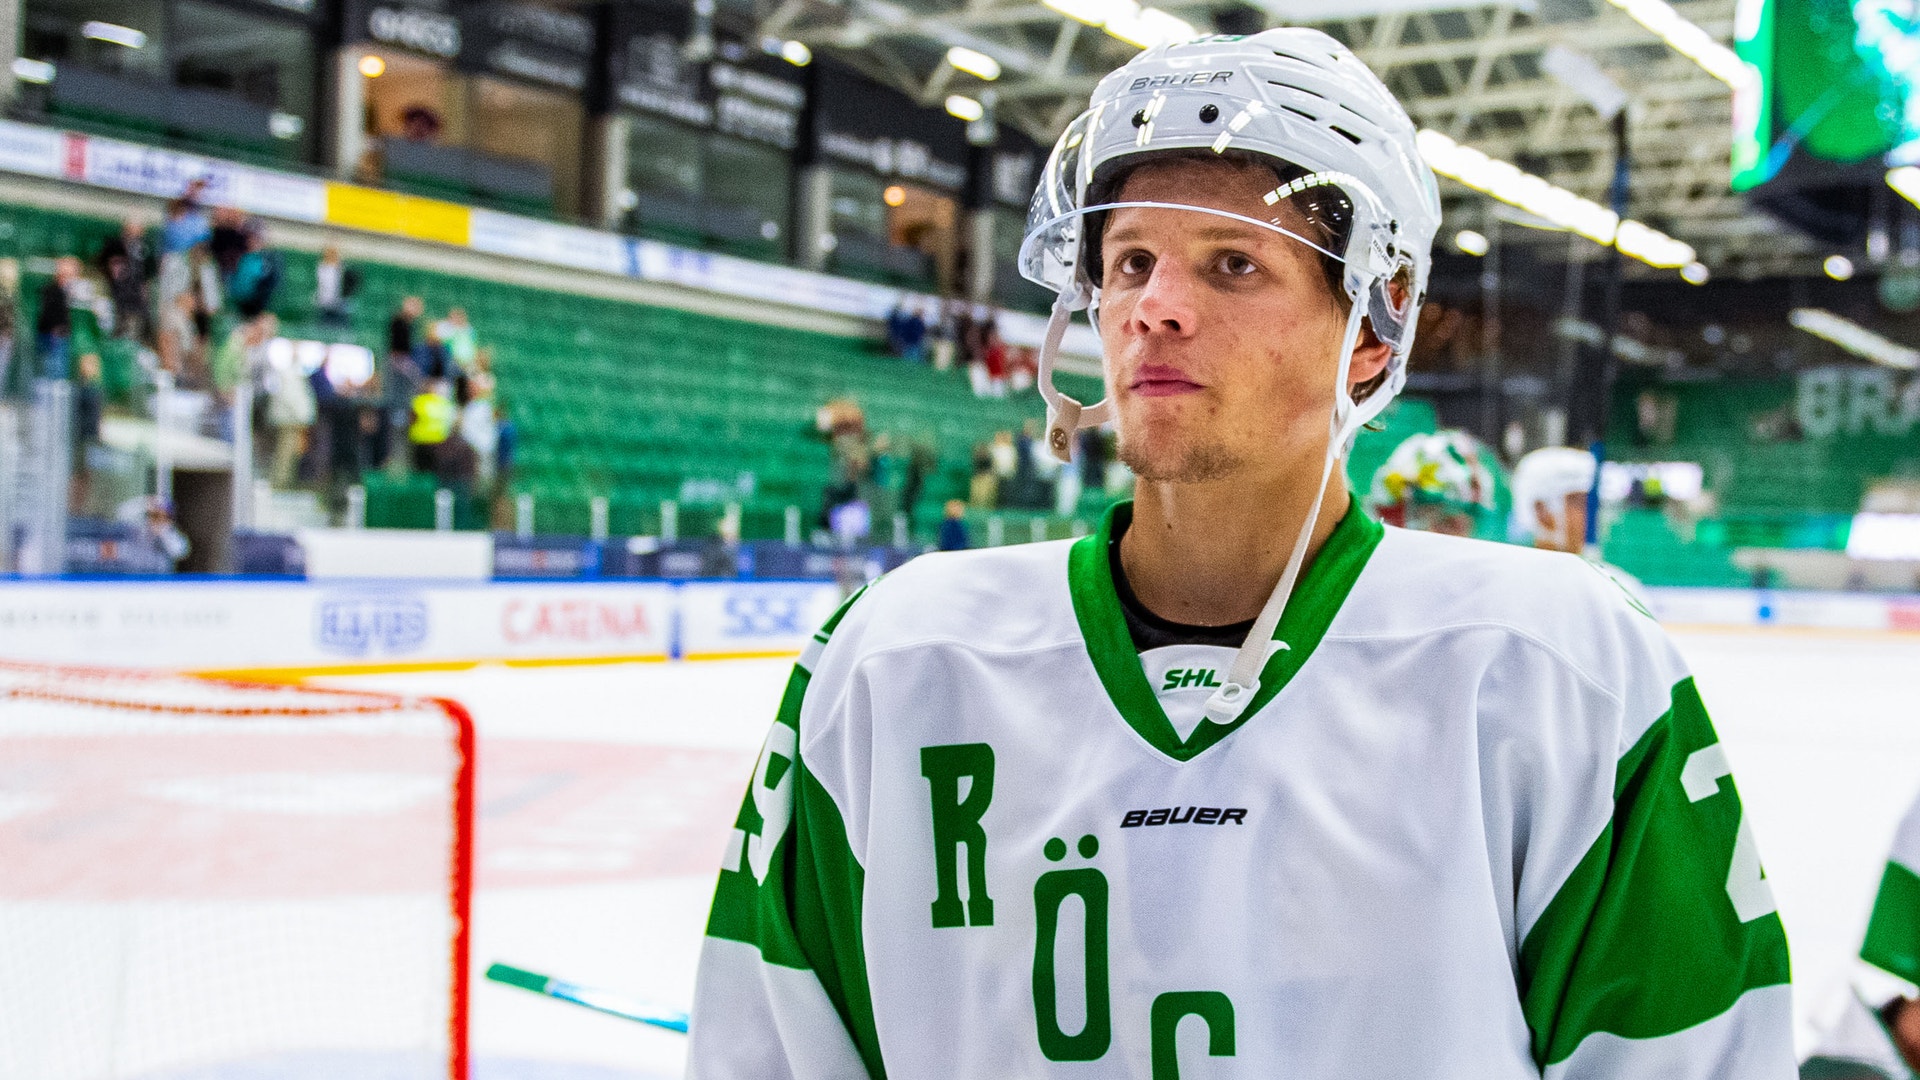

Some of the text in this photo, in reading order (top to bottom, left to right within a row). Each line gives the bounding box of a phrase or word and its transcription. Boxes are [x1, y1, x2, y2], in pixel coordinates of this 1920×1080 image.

[1129, 71, 1234, 91] BAUER
[1162, 668, 1222, 691] SHL
[720, 720, 798, 887] 9
[1120, 806, 1248, 828] BAUER
